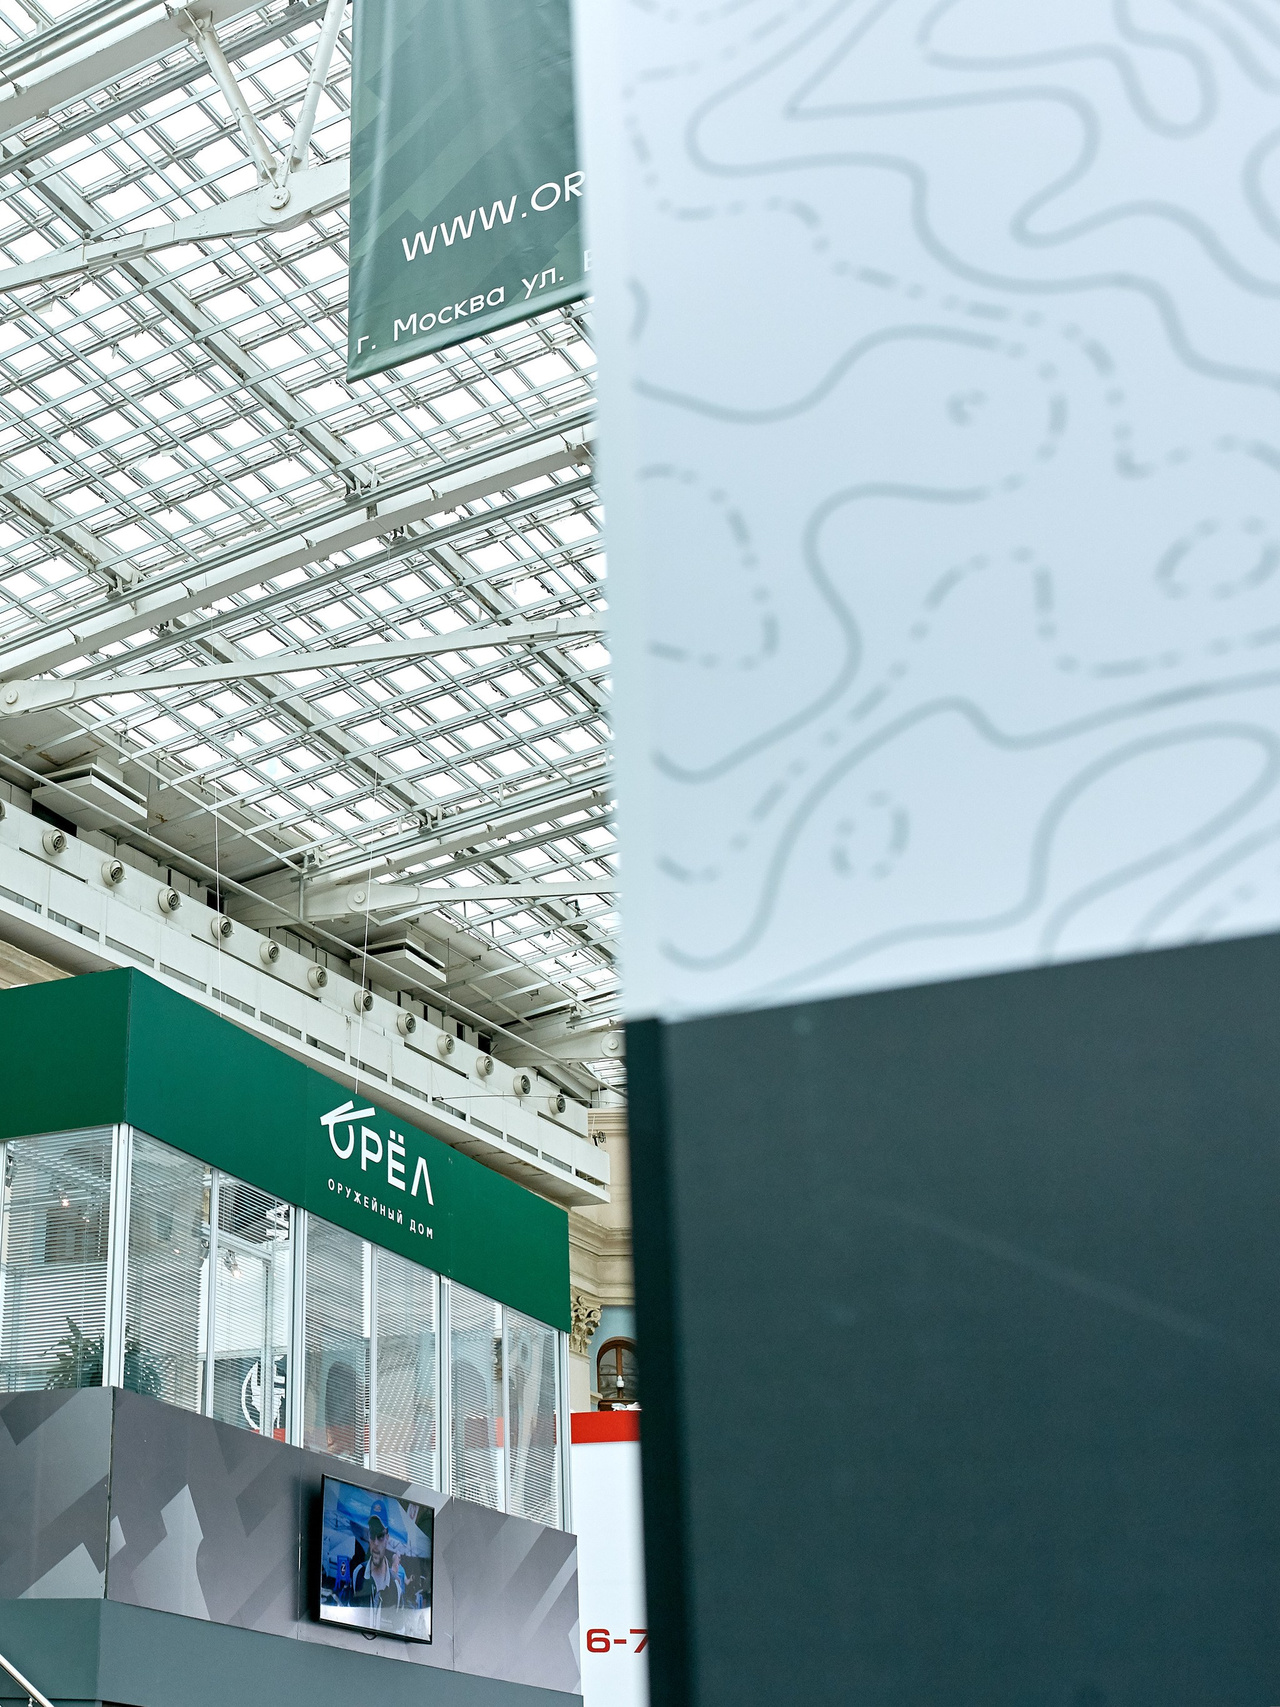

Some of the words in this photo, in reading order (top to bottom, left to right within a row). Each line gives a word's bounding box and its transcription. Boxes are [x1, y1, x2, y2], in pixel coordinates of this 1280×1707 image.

[401, 170, 586, 262] WWW.OR
[357, 335, 376, 354] г.
[393, 286, 505, 341] Москва
[521, 267, 564, 300] ул.
[320, 1100, 434, 1206] ОРЁЛ
[327, 1178, 403, 1225] ОРУЖЕЙНЫЙ
[409, 1218, 434, 1240] ДОМ
[586, 1628, 649, 1654] 6-7
